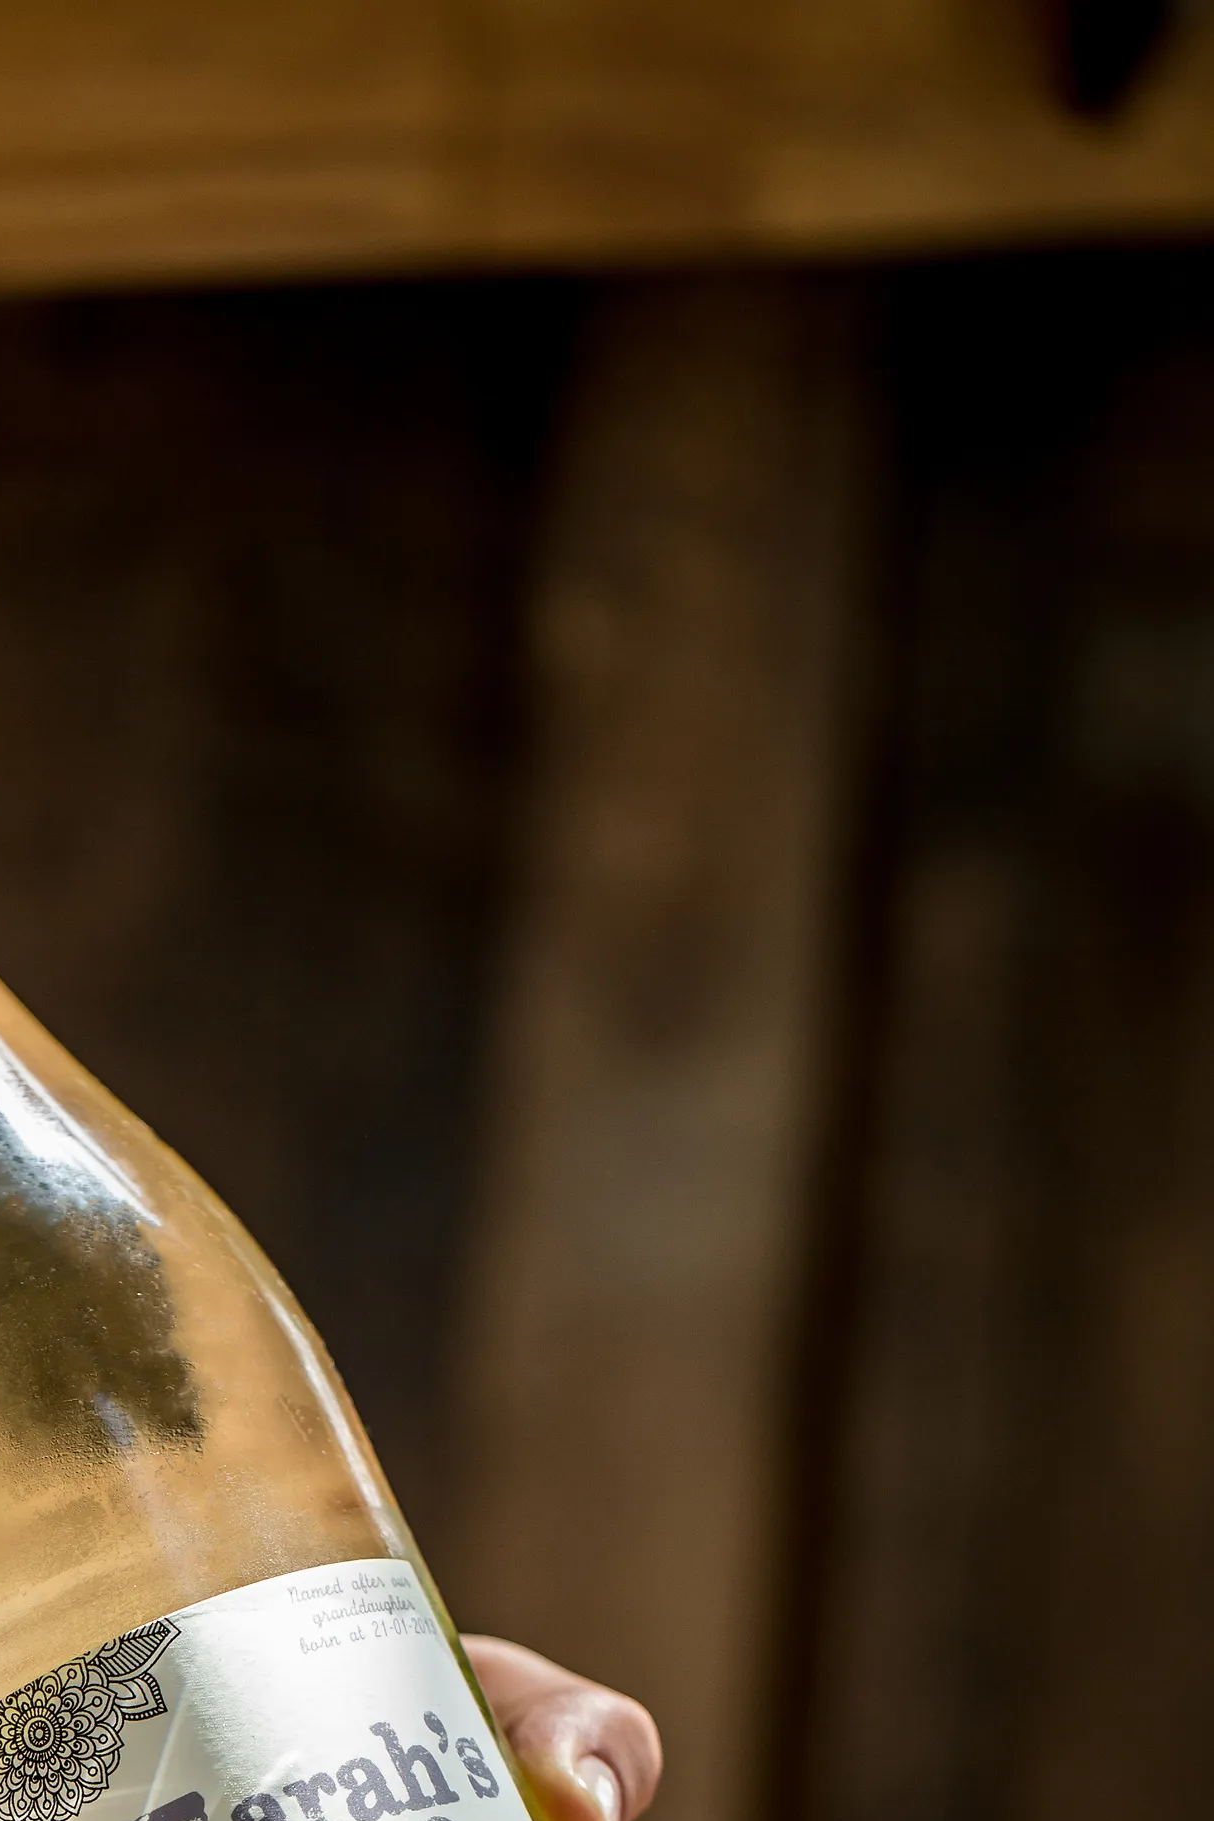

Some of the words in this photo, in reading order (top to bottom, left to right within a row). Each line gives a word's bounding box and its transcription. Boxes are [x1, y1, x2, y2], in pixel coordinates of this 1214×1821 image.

[288, 1578, 344, 1604] Named
[352, 1572, 386, 1595] after
[312, 1597, 415, 1627] granddaughter
[300, 1636, 341, 1654] born
[349, 1625, 366, 1643] at
